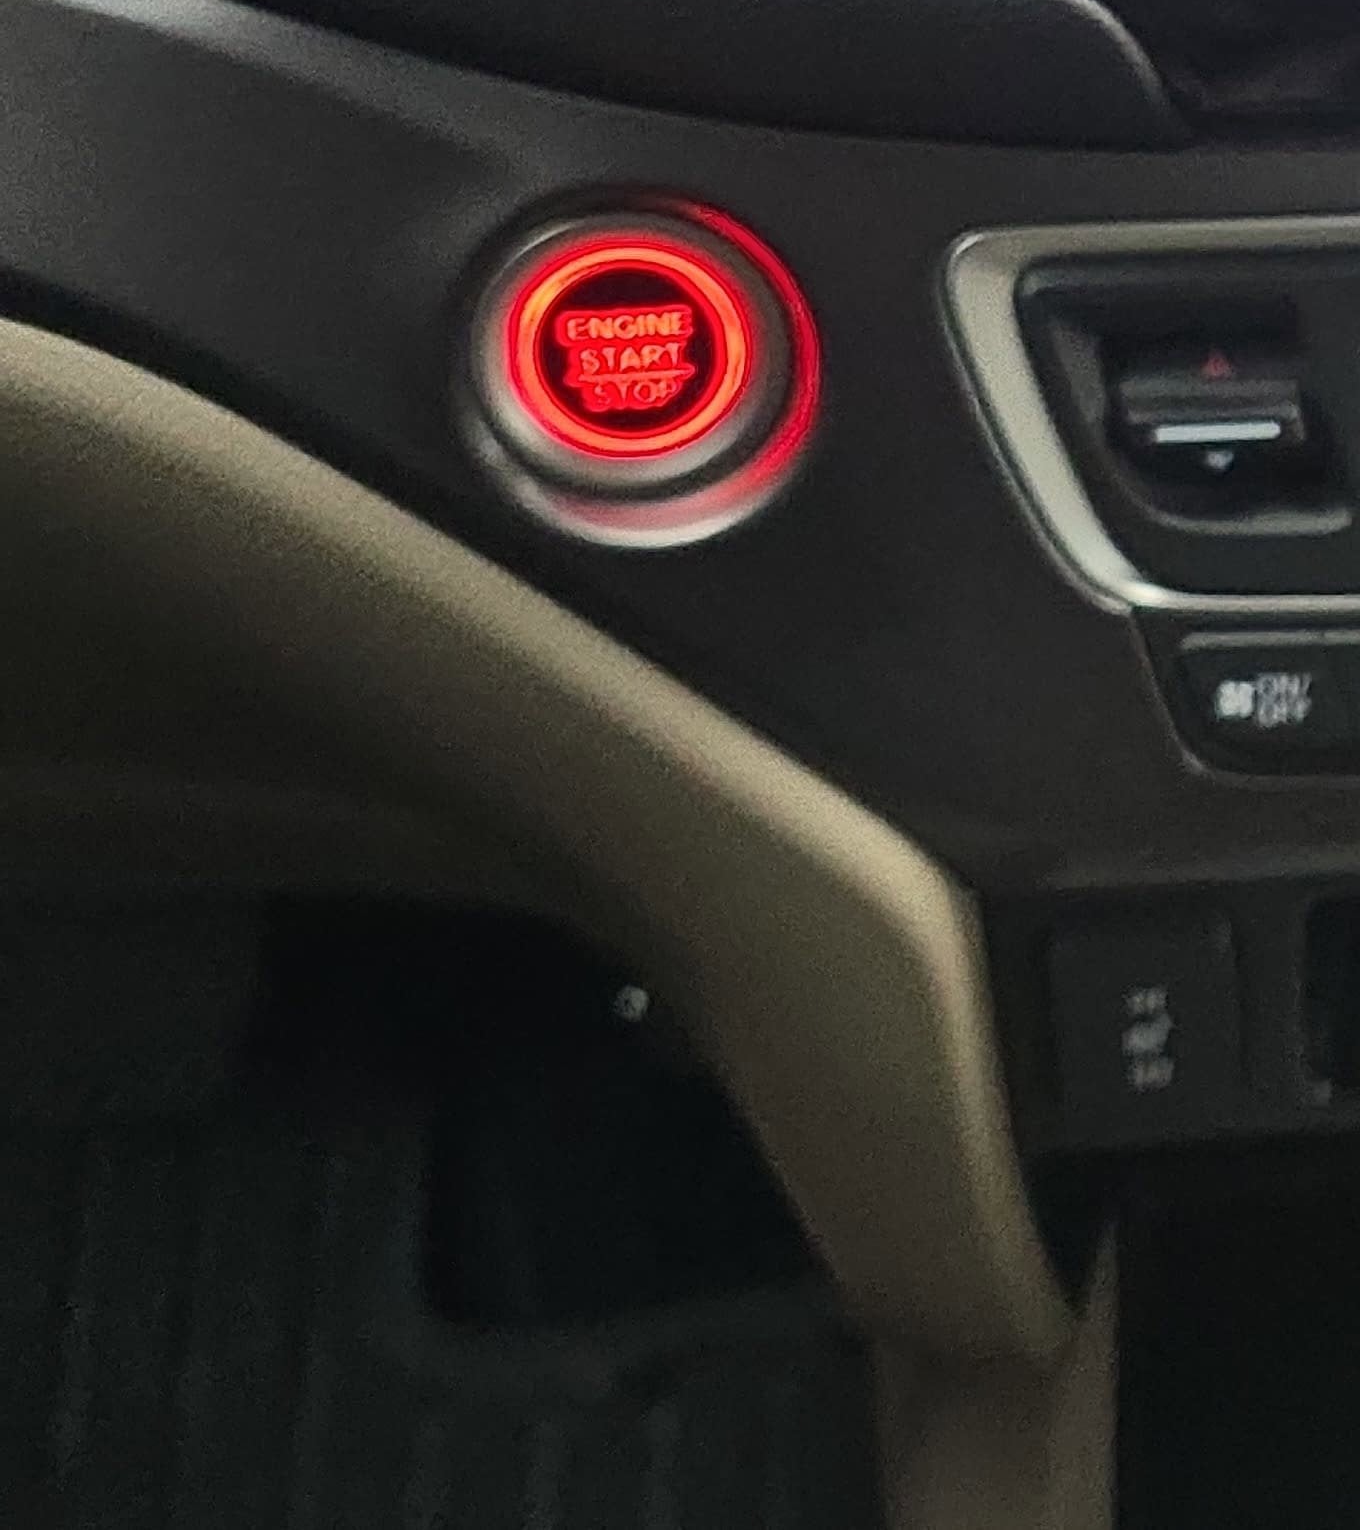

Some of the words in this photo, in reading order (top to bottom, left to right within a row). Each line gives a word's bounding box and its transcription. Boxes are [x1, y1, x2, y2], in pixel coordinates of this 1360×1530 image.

[566, 311, 691, 342] ENGINE
[580, 343, 681, 374] START
[591, 378, 678, 409] STOP
